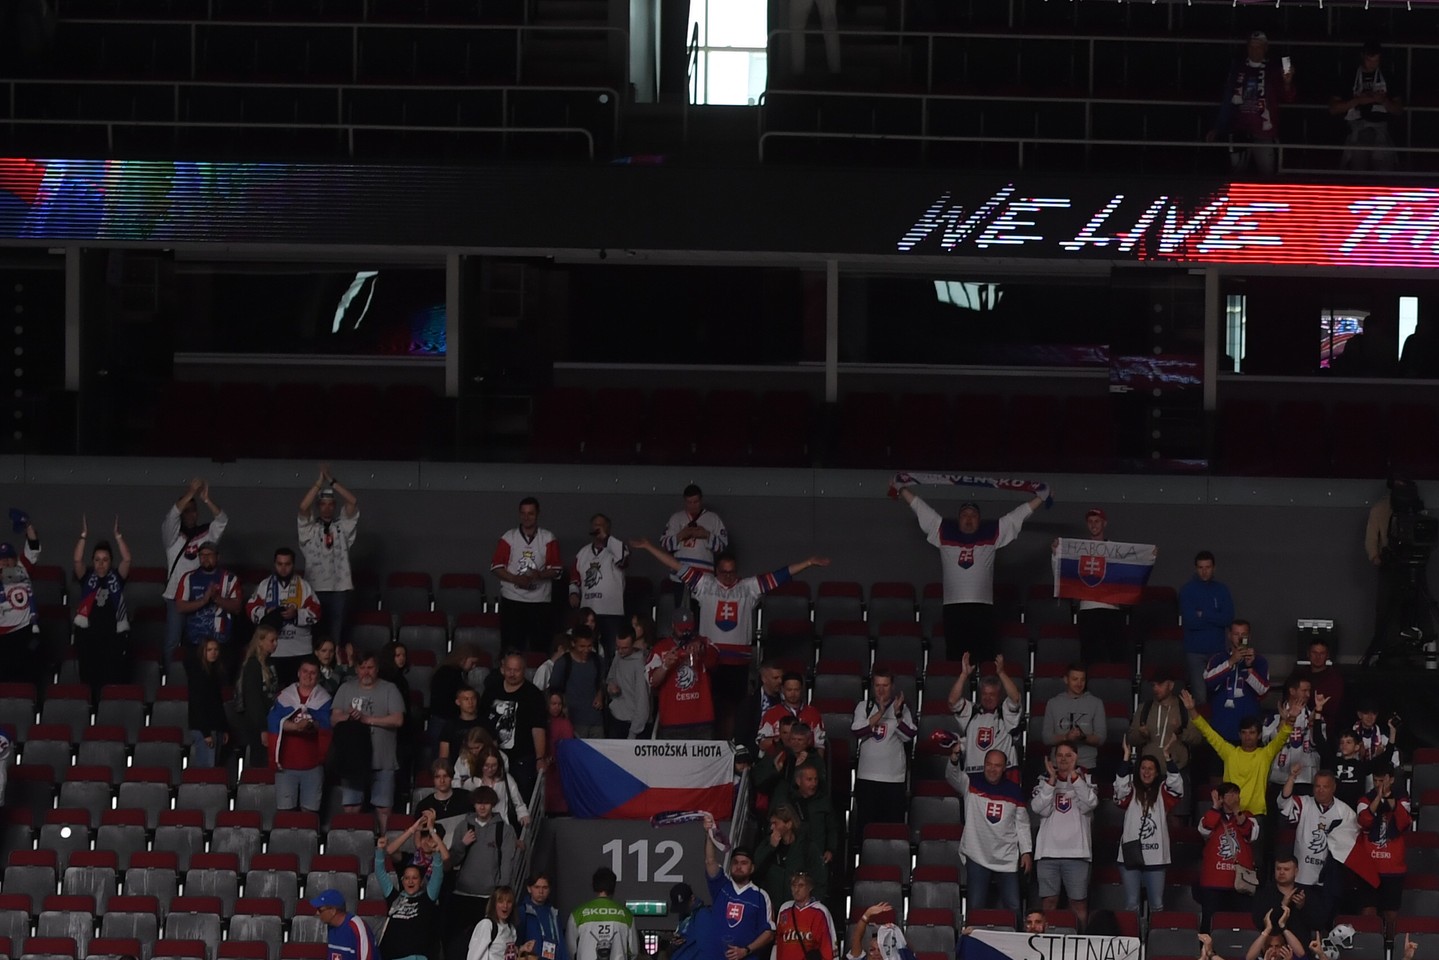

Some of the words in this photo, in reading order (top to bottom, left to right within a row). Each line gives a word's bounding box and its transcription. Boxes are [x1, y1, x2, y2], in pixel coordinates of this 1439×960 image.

[897, 184, 1071, 252] WE
[1058, 194, 1291, 253] LIVE
[634, 742, 688, 758] OSTROŽSKÁ
[691, 744, 722, 758] LHOTA
[602, 839, 684, 883] 112
[598, 924, 611, 935] 25
